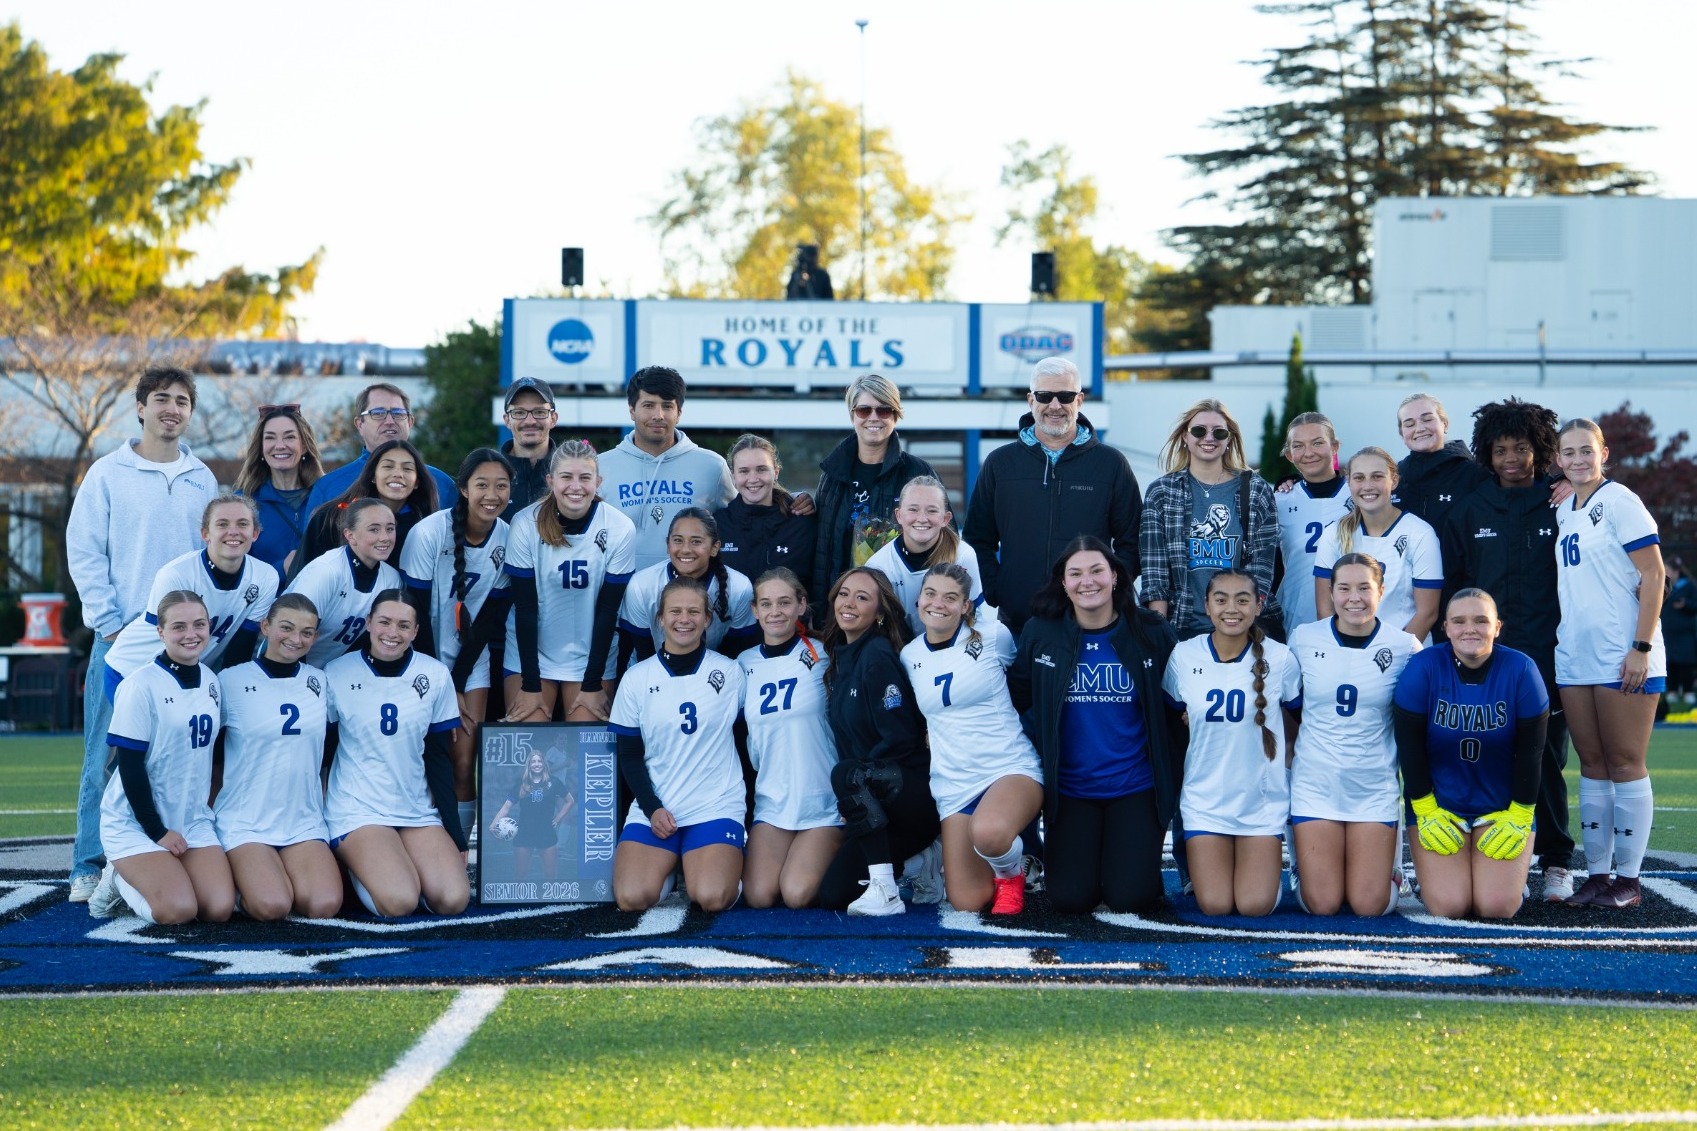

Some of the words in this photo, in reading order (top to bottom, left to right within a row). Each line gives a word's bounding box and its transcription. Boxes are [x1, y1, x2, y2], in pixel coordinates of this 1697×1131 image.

[725, 317, 790, 334] HOME
[799, 317, 826, 334] OF
[838, 317, 880, 334] THE
[701, 338, 904, 368] ROYALS
[999, 333, 1073, 353] ODAC
[618, 480, 694, 500] ROYALS
[661, 496, 692, 504] SOCCER
[1189, 537, 1236, 560] EMU
[1196, 559, 1224, 567] SOCCER
[1560, 532, 1581, 568] 16
[558, 560, 589, 590] 15
[333, 616, 366, 645] 13
[759, 677, 798, 716] 27
[934, 671, 954, 707] 7
[1065, 695, 1098, 703] OMEN'S
[1099, 695, 1132, 703] SOCCER
[1335, 683, 1358, 718] 9
[280, 703, 302, 736] 2
[380, 703, 399, 736] 8
[679, 702, 698, 735] 3
[1205, 688, 1246, 723] 20
[1433, 698, 1508, 732] ROYALS
[189, 713, 213, 748] 19
[485, 732, 534, 767] #15
[1459, 737, 1481, 763] 0
[584, 752, 614, 863] KEPLER
[484, 882, 538, 901] SENIOR
[542, 881, 580, 900] 2026
